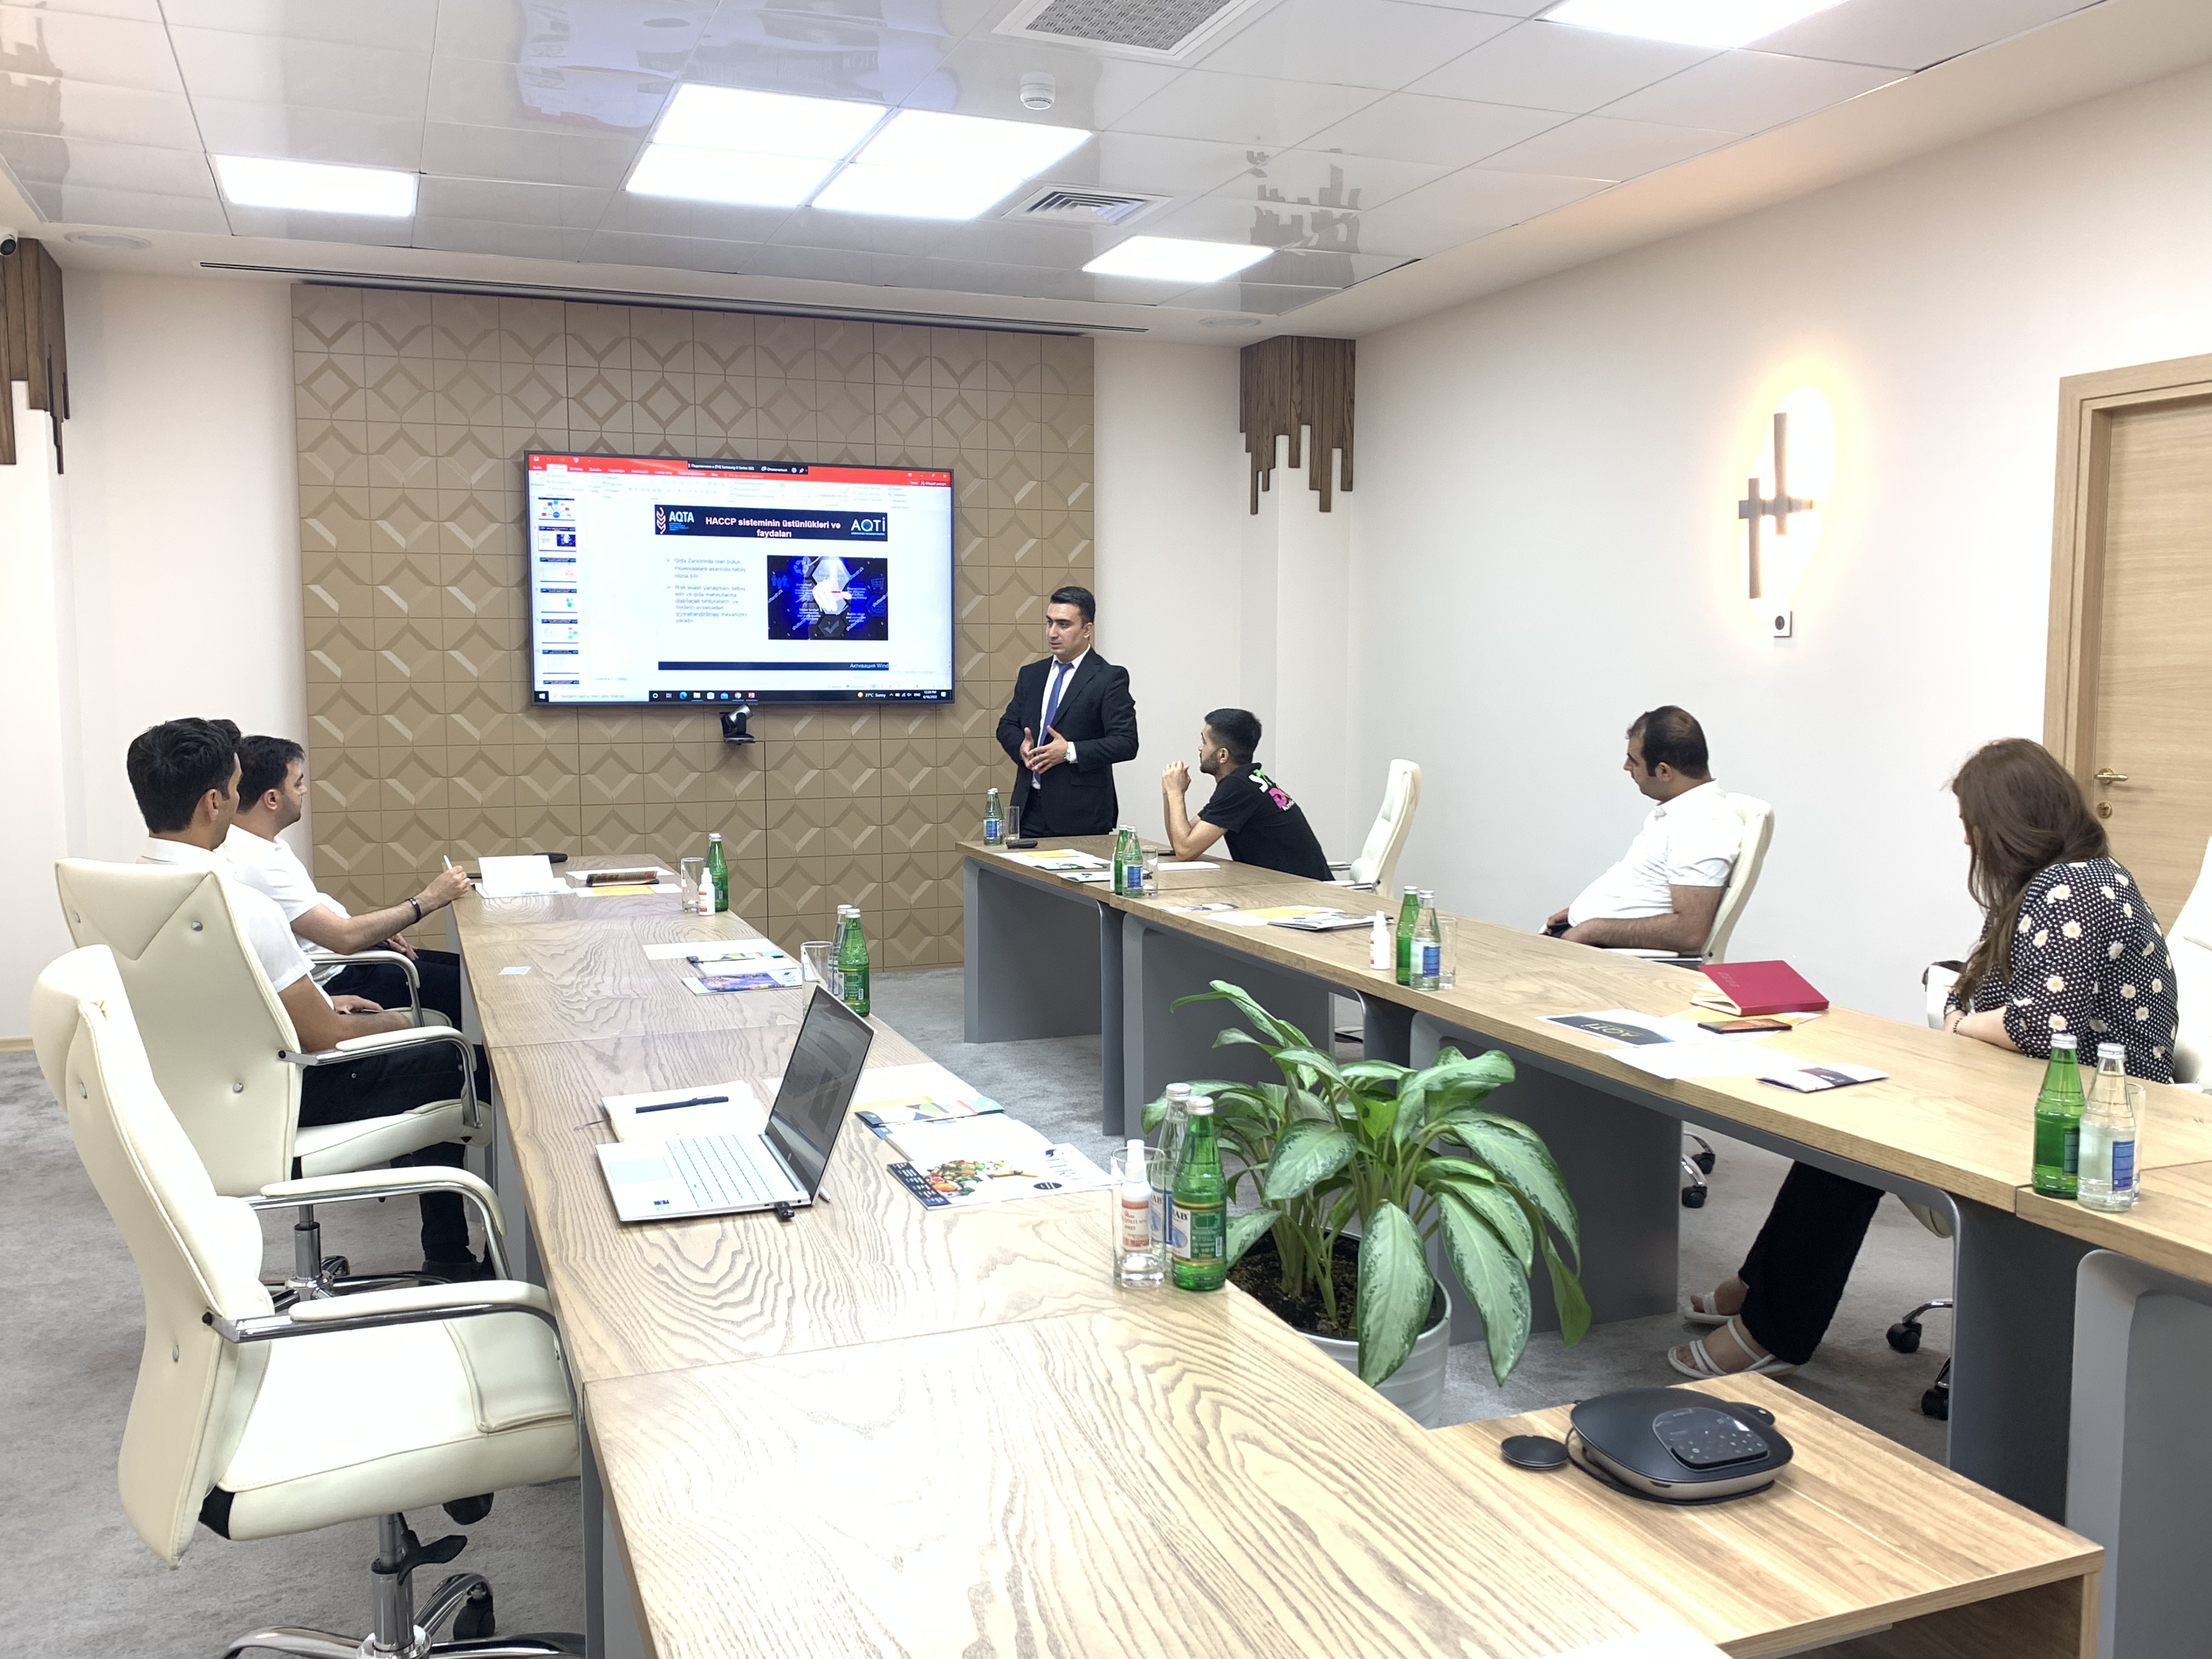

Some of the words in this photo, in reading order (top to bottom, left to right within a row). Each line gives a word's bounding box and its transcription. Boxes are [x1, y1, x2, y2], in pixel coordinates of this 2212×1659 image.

[669, 511, 694, 522] AQTA
[706, 517, 736, 525] HACCP
[738, 518, 780, 527] sisteminin
